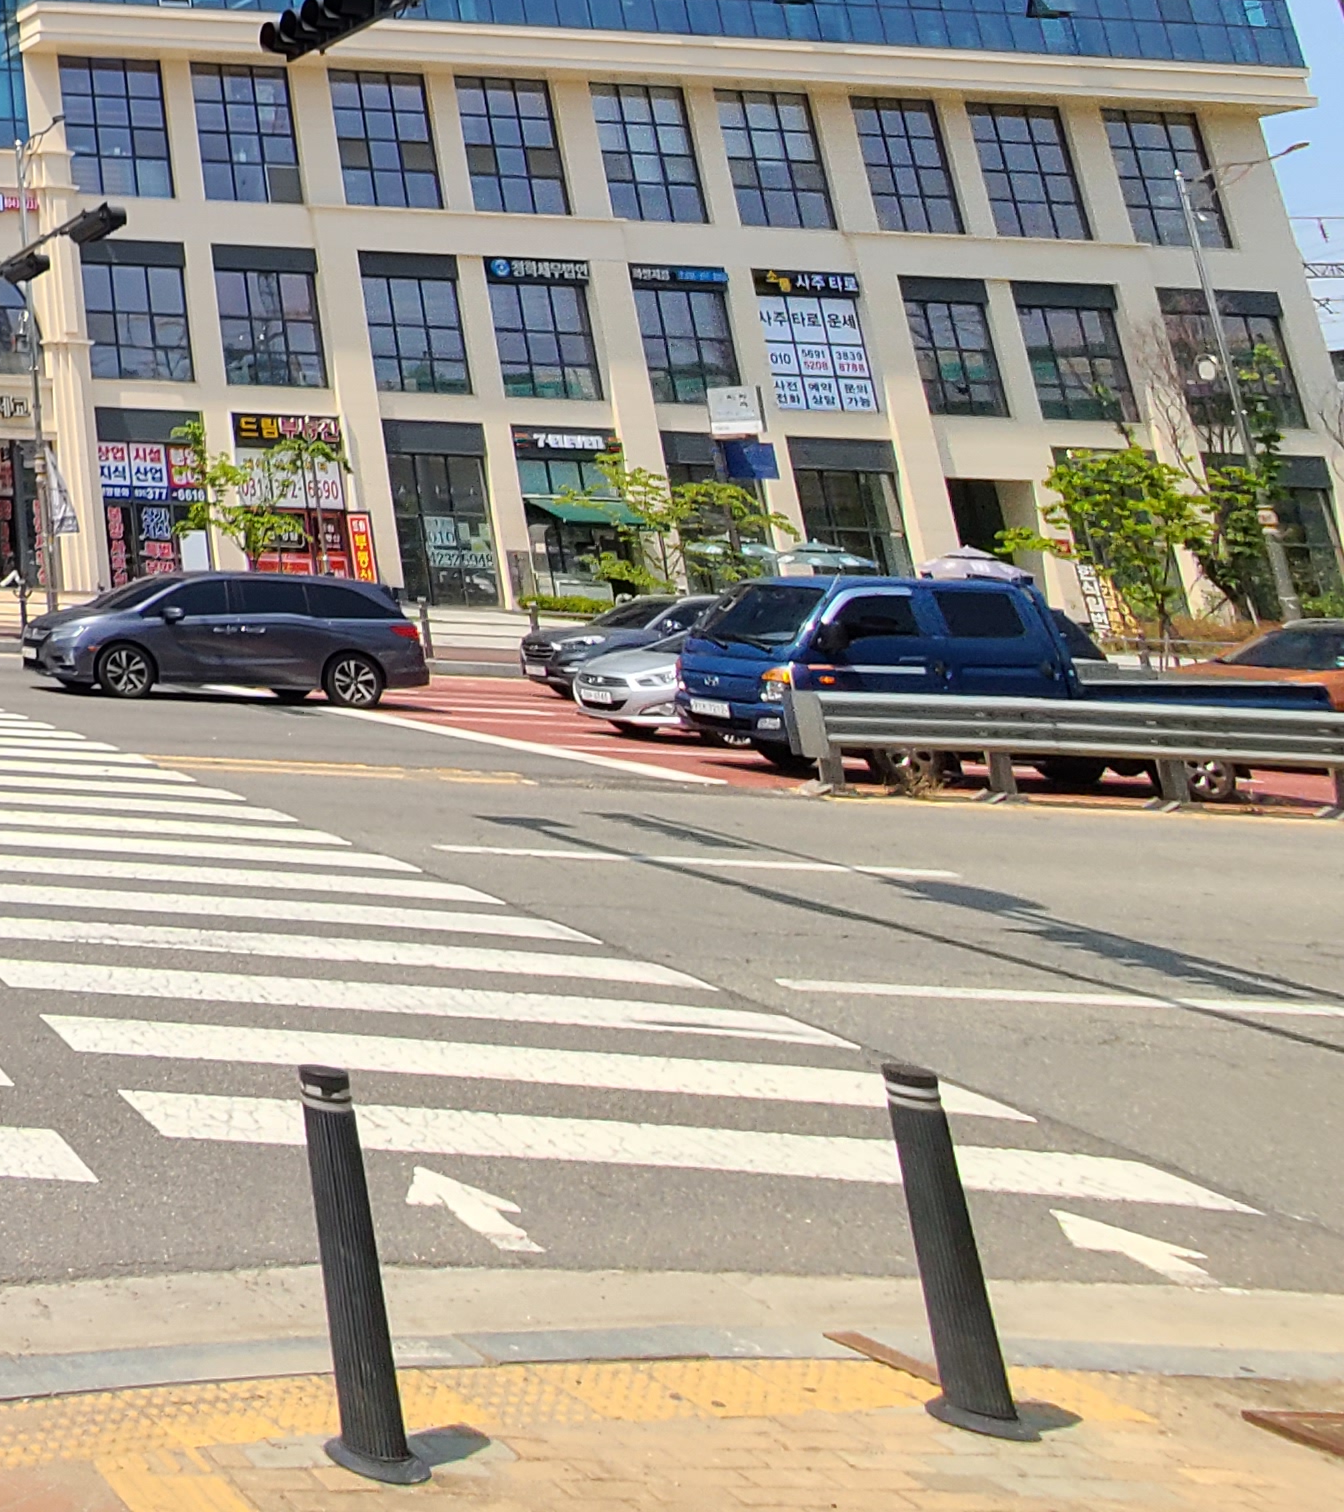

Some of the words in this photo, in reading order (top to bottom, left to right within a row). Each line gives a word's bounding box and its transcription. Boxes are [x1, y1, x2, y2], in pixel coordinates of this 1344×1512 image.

[759, 310, 788, 327] 사주
[792, 311, 822, 328] 타로
[827, 313, 857, 330] 운세
[770, 352, 792, 365] 010
[133, 446, 162, 463] 시설
